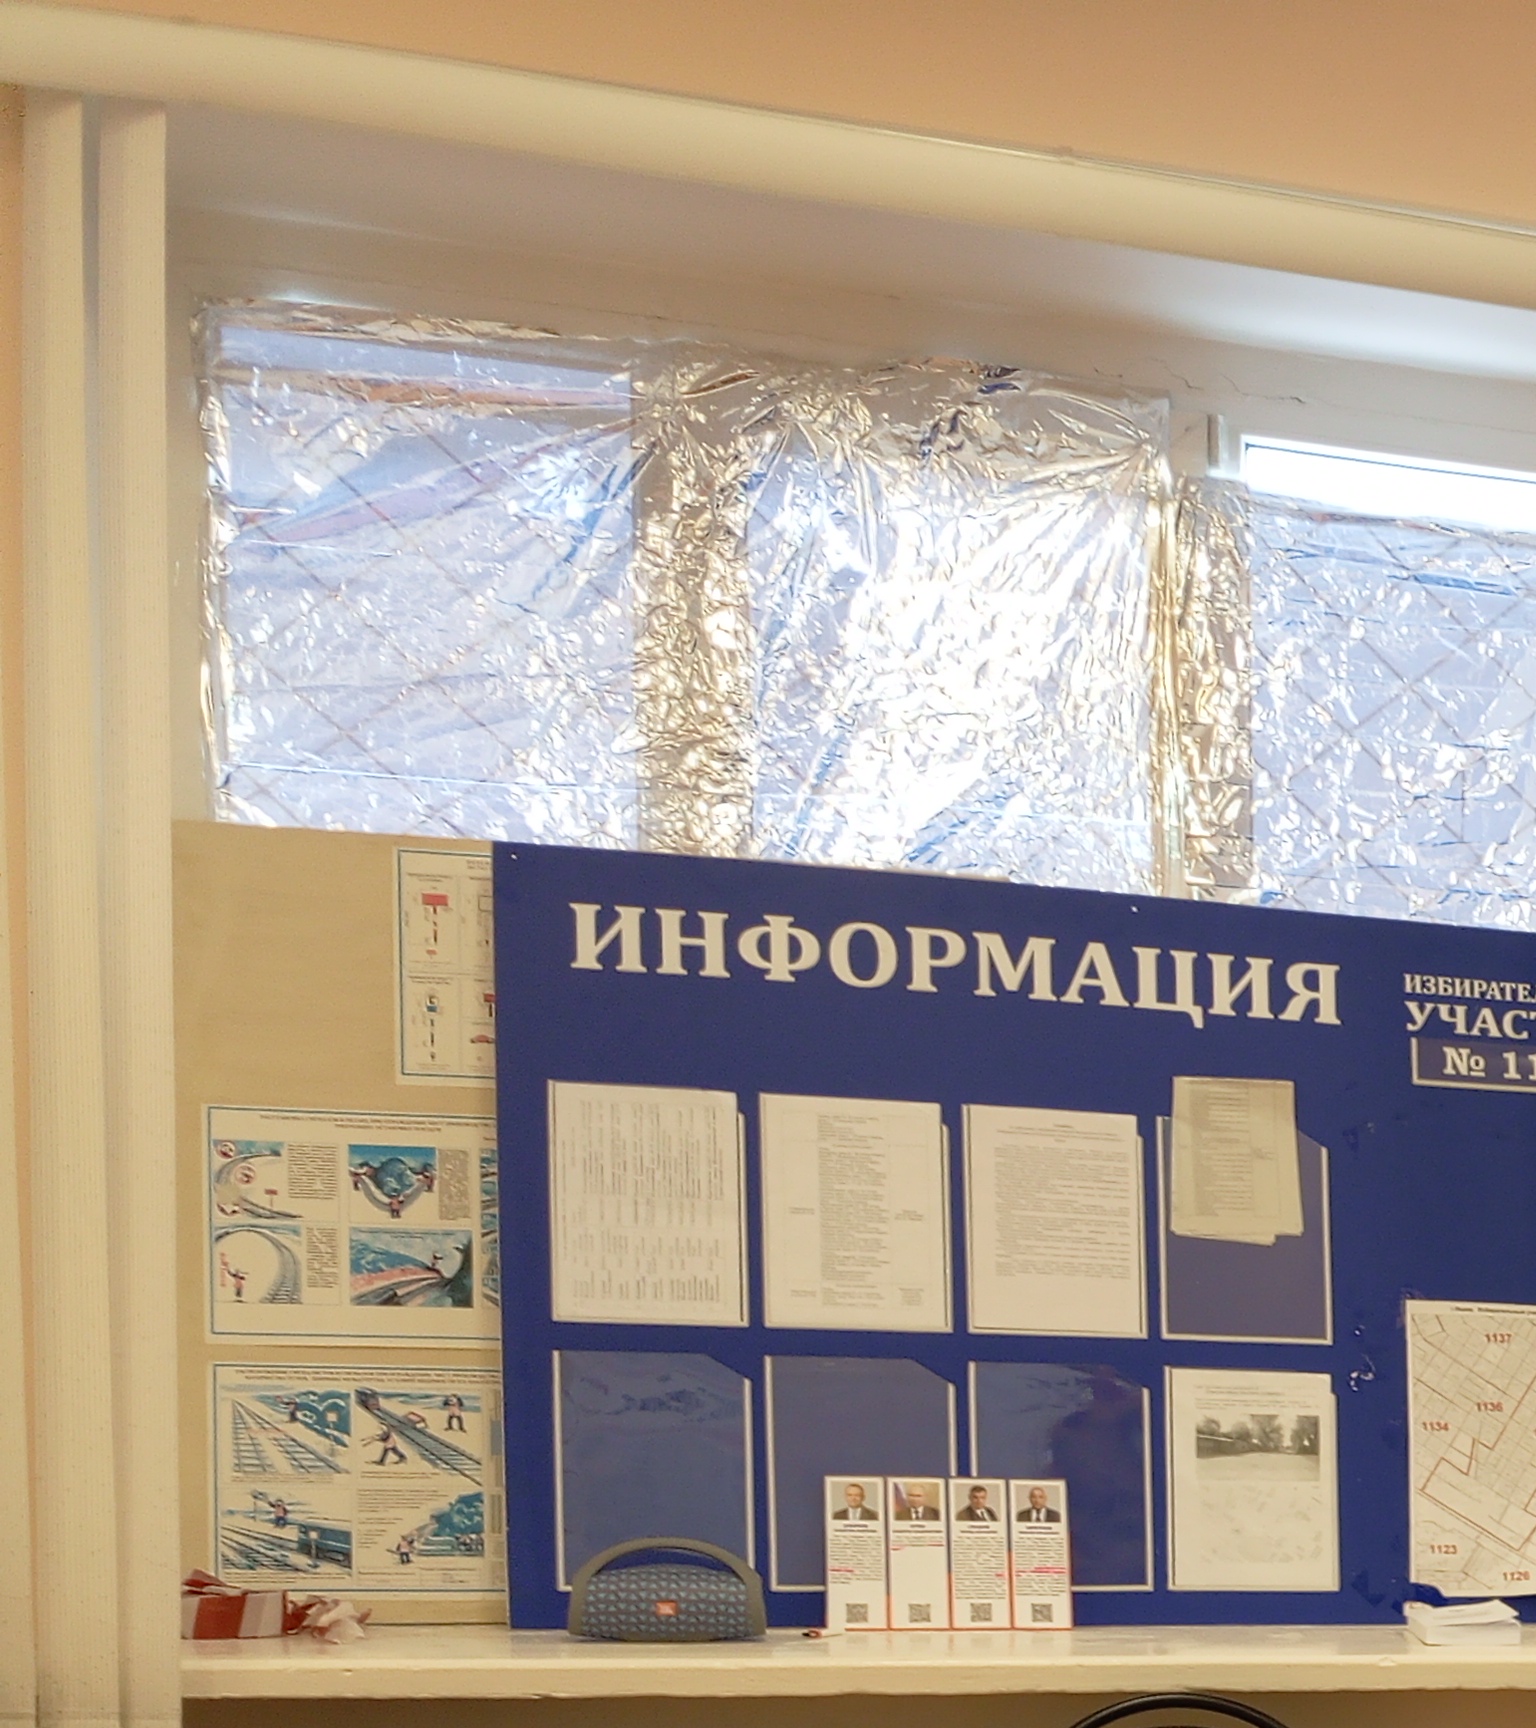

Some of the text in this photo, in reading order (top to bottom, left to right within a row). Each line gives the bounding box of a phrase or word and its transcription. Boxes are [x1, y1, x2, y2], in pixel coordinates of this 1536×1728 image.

[569, 902, 1342, 1028] ИНФОРМАЦИЯ
[1442, 1046, 1487, 1078] №
[1484, 1333, 1512, 1344] 1137
[1421, 1421, 1449, 1432] 1134
[1429, 1544, 1458, 1555] 1123
